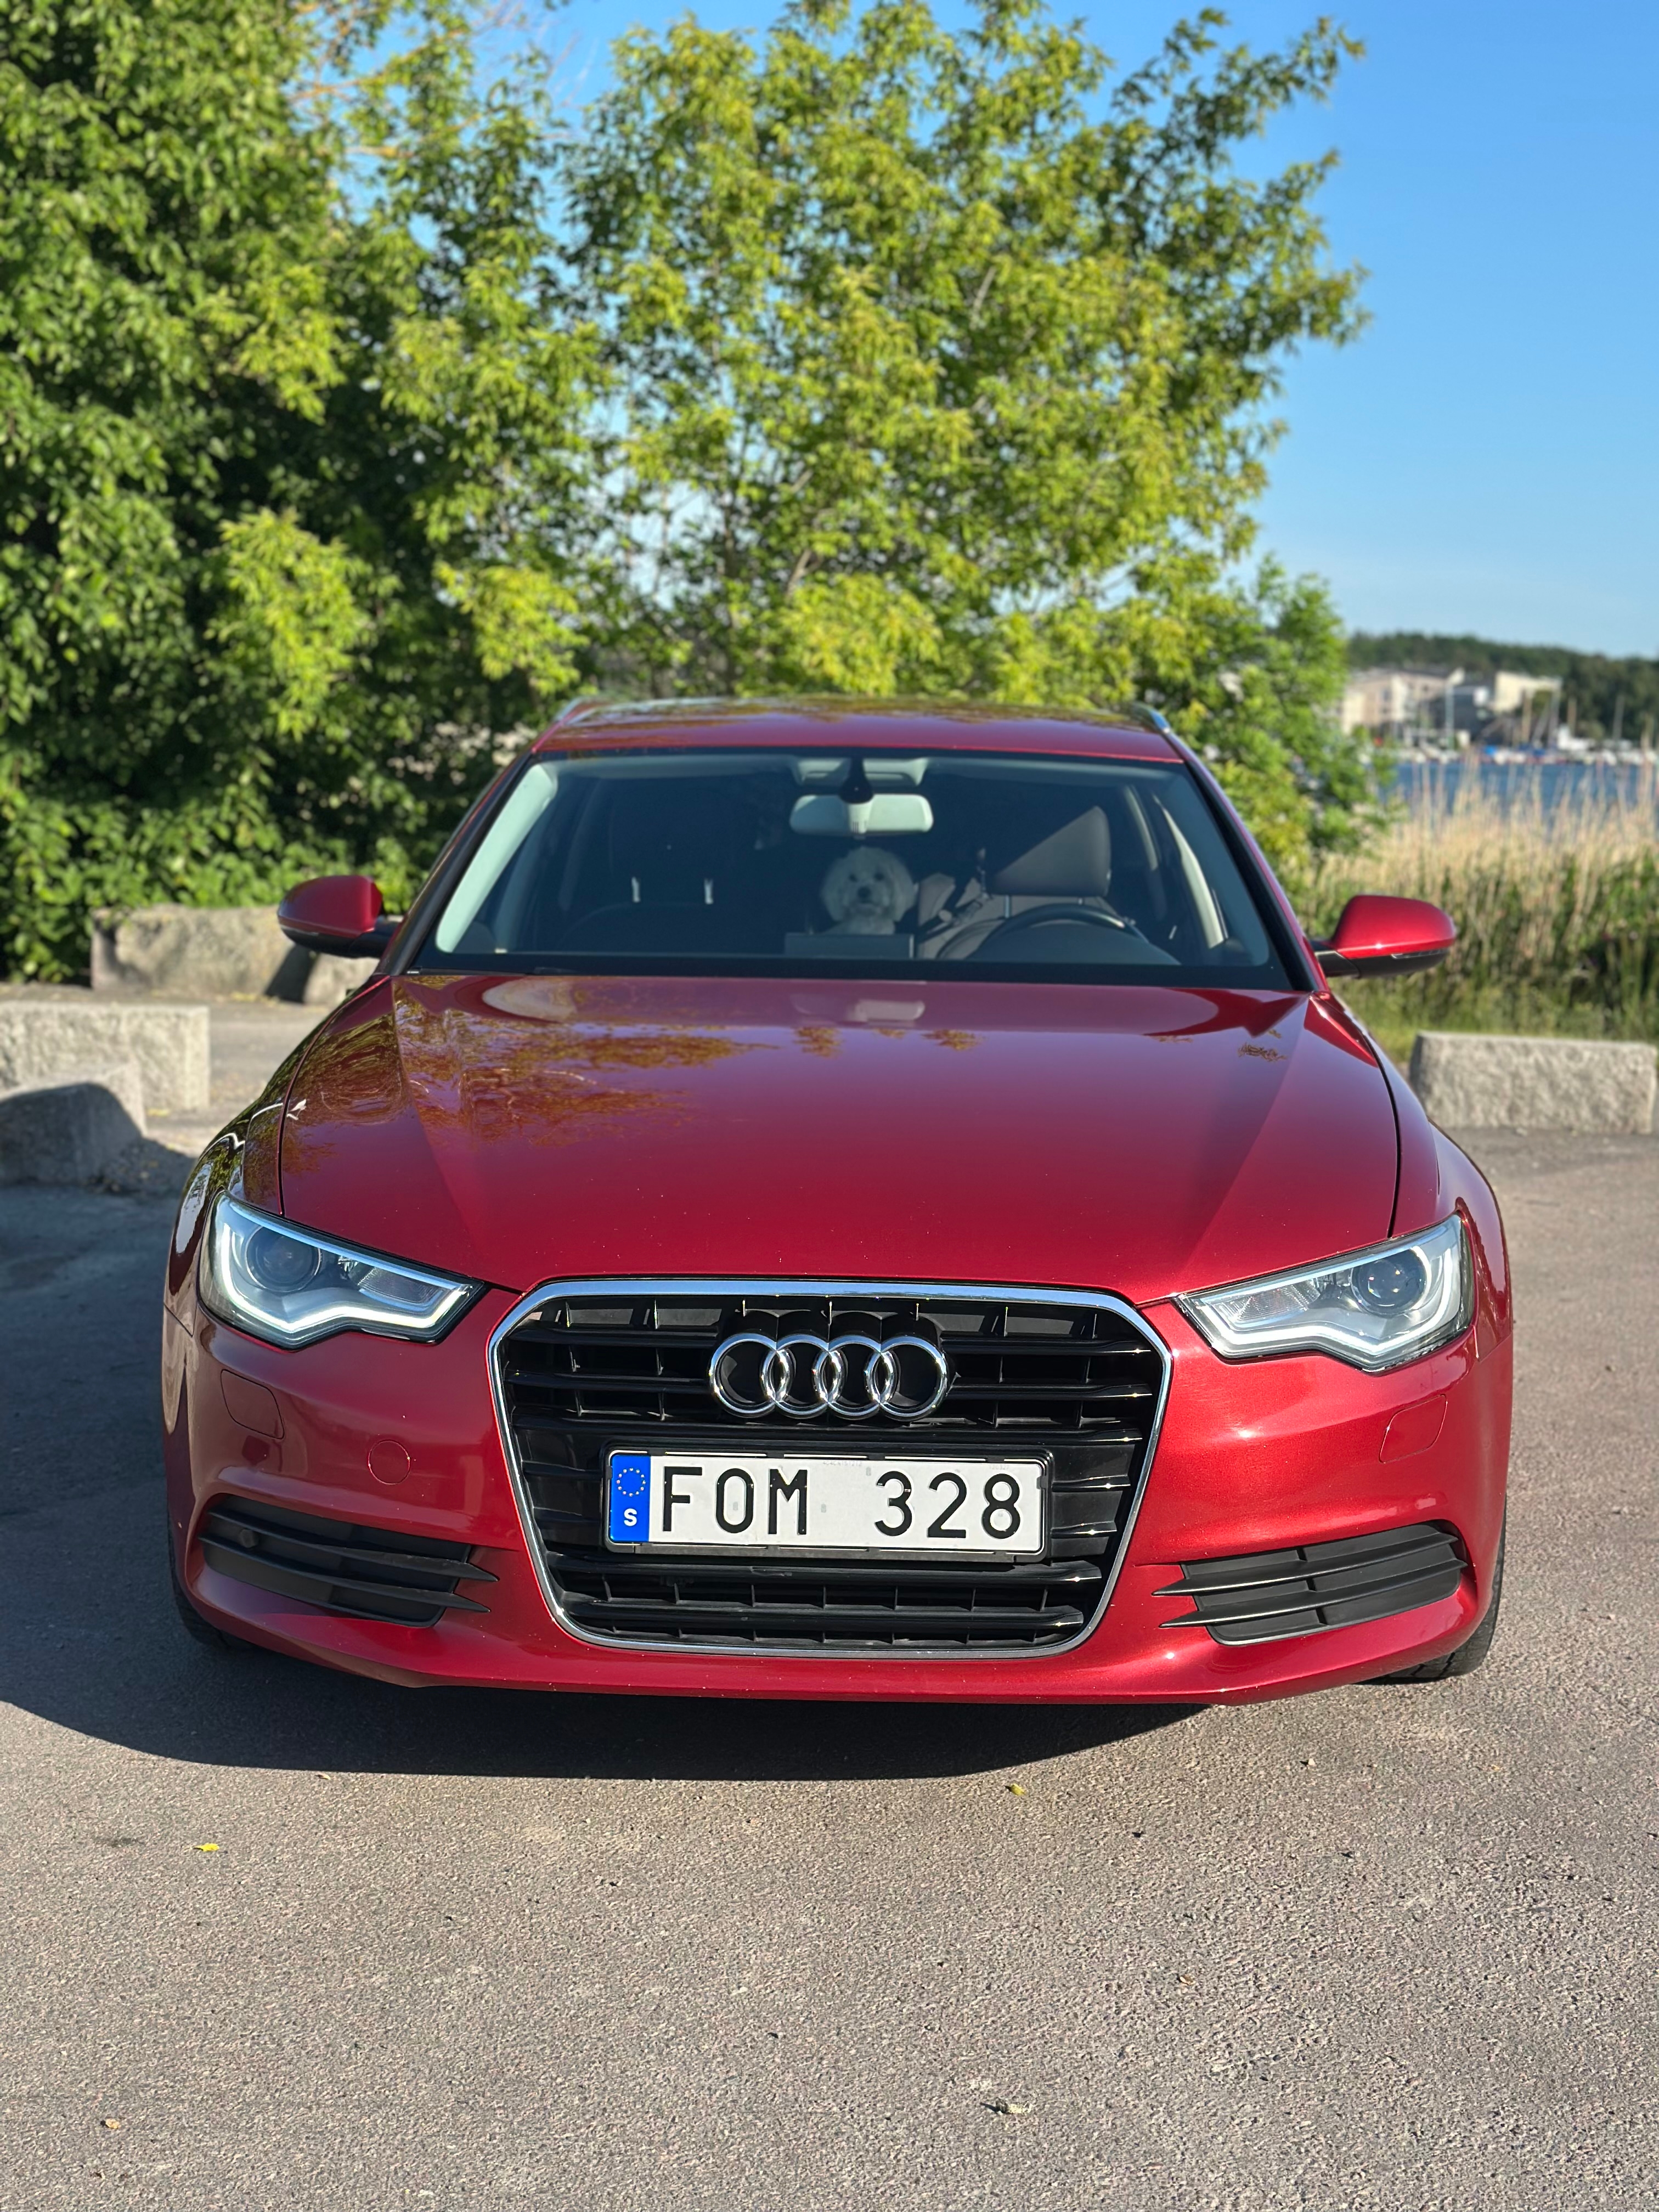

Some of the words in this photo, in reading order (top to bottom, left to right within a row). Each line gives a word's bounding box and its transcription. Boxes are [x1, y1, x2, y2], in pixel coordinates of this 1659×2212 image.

[624, 1508, 637, 1526] S
[663, 1466, 808, 1535] FOM
[874, 1470, 1021, 1539] 328
